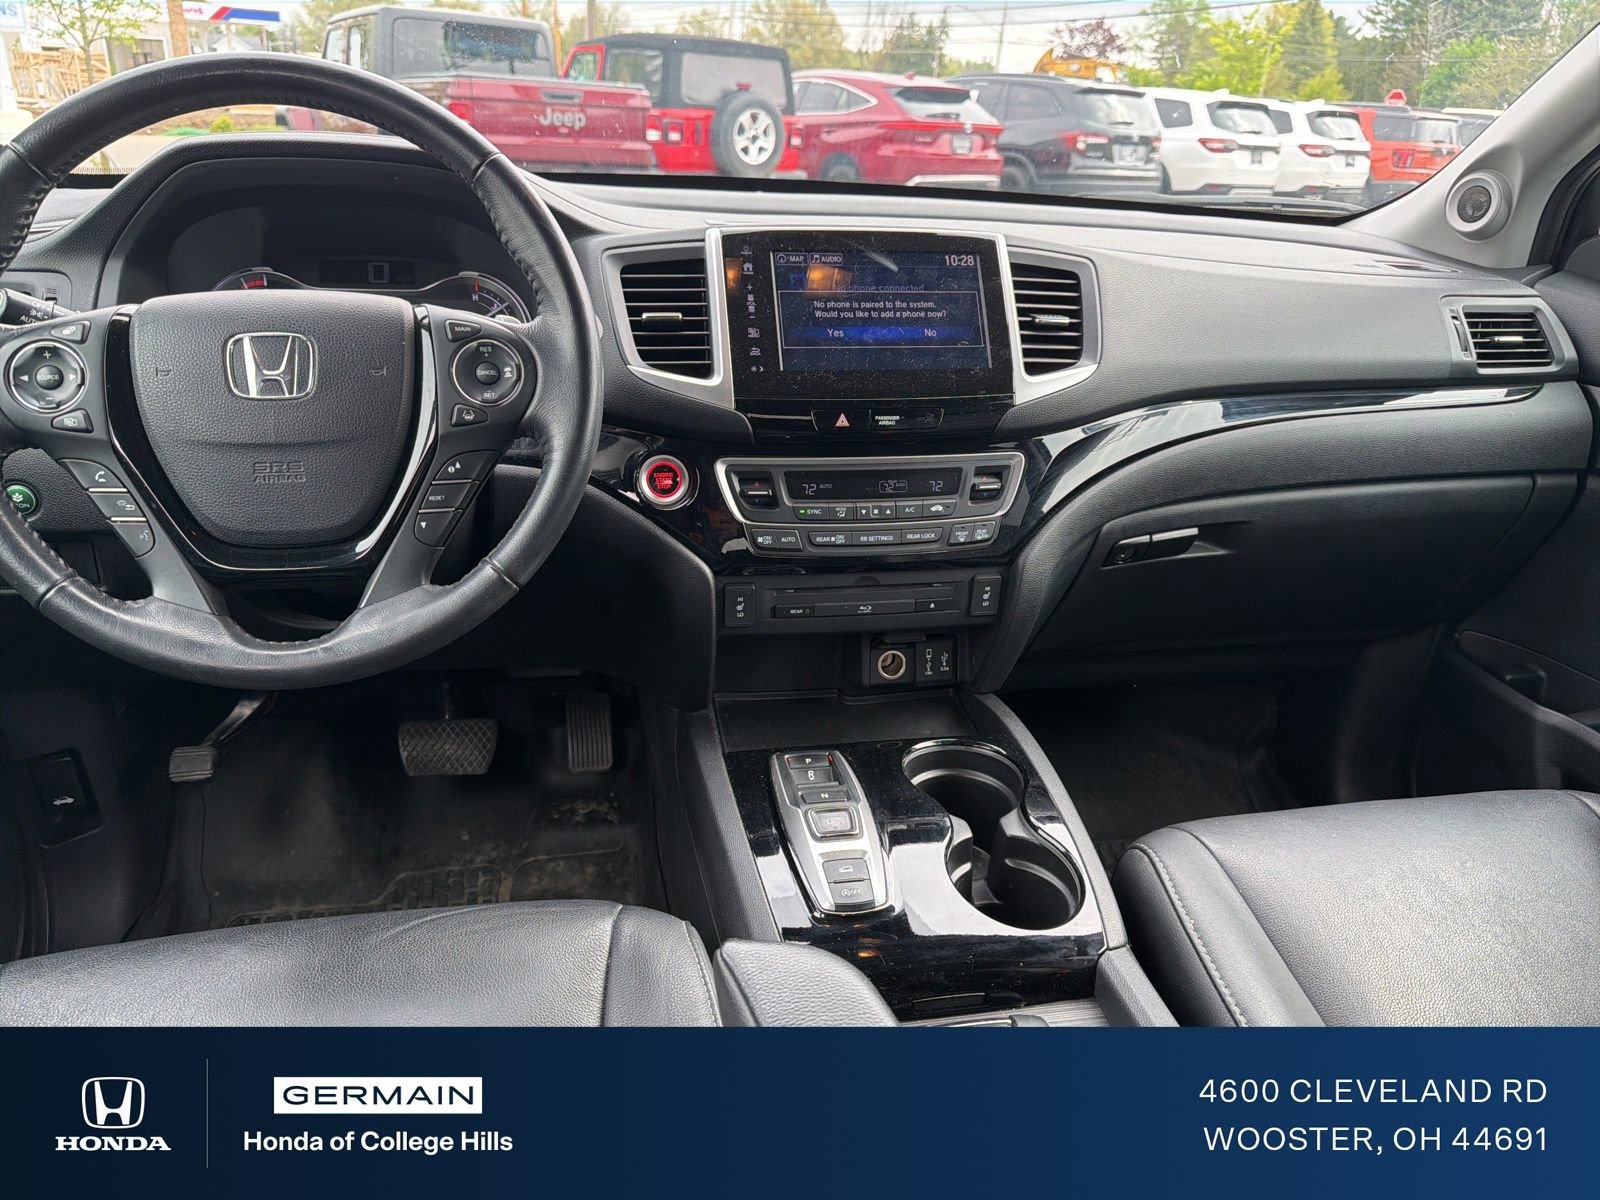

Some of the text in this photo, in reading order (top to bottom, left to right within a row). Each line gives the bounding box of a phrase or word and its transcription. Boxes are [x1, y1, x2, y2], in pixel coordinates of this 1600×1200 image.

[538, 108, 586, 131] Jeep
[821, 255, 842, 263] AUDIO
[945, 255, 975, 267] 10:28
[827, 301, 850, 310] phone
[861, 301, 884, 310] paired
[910, 301, 936, 310] system.
[840, 312, 853, 320] you
[881, 310, 894, 318] add
[903, 311, 926, 320] phone
[928, 310, 947, 320] now?
[827, 328, 844, 338] Yes
[925, 329, 937, 337] No
[254, 475, 306, 484] AIRBAG
[802, 484, 817, 496] 72
[929, 480, 943, 492] 72
[921, 532, 936, 540] LOCK
